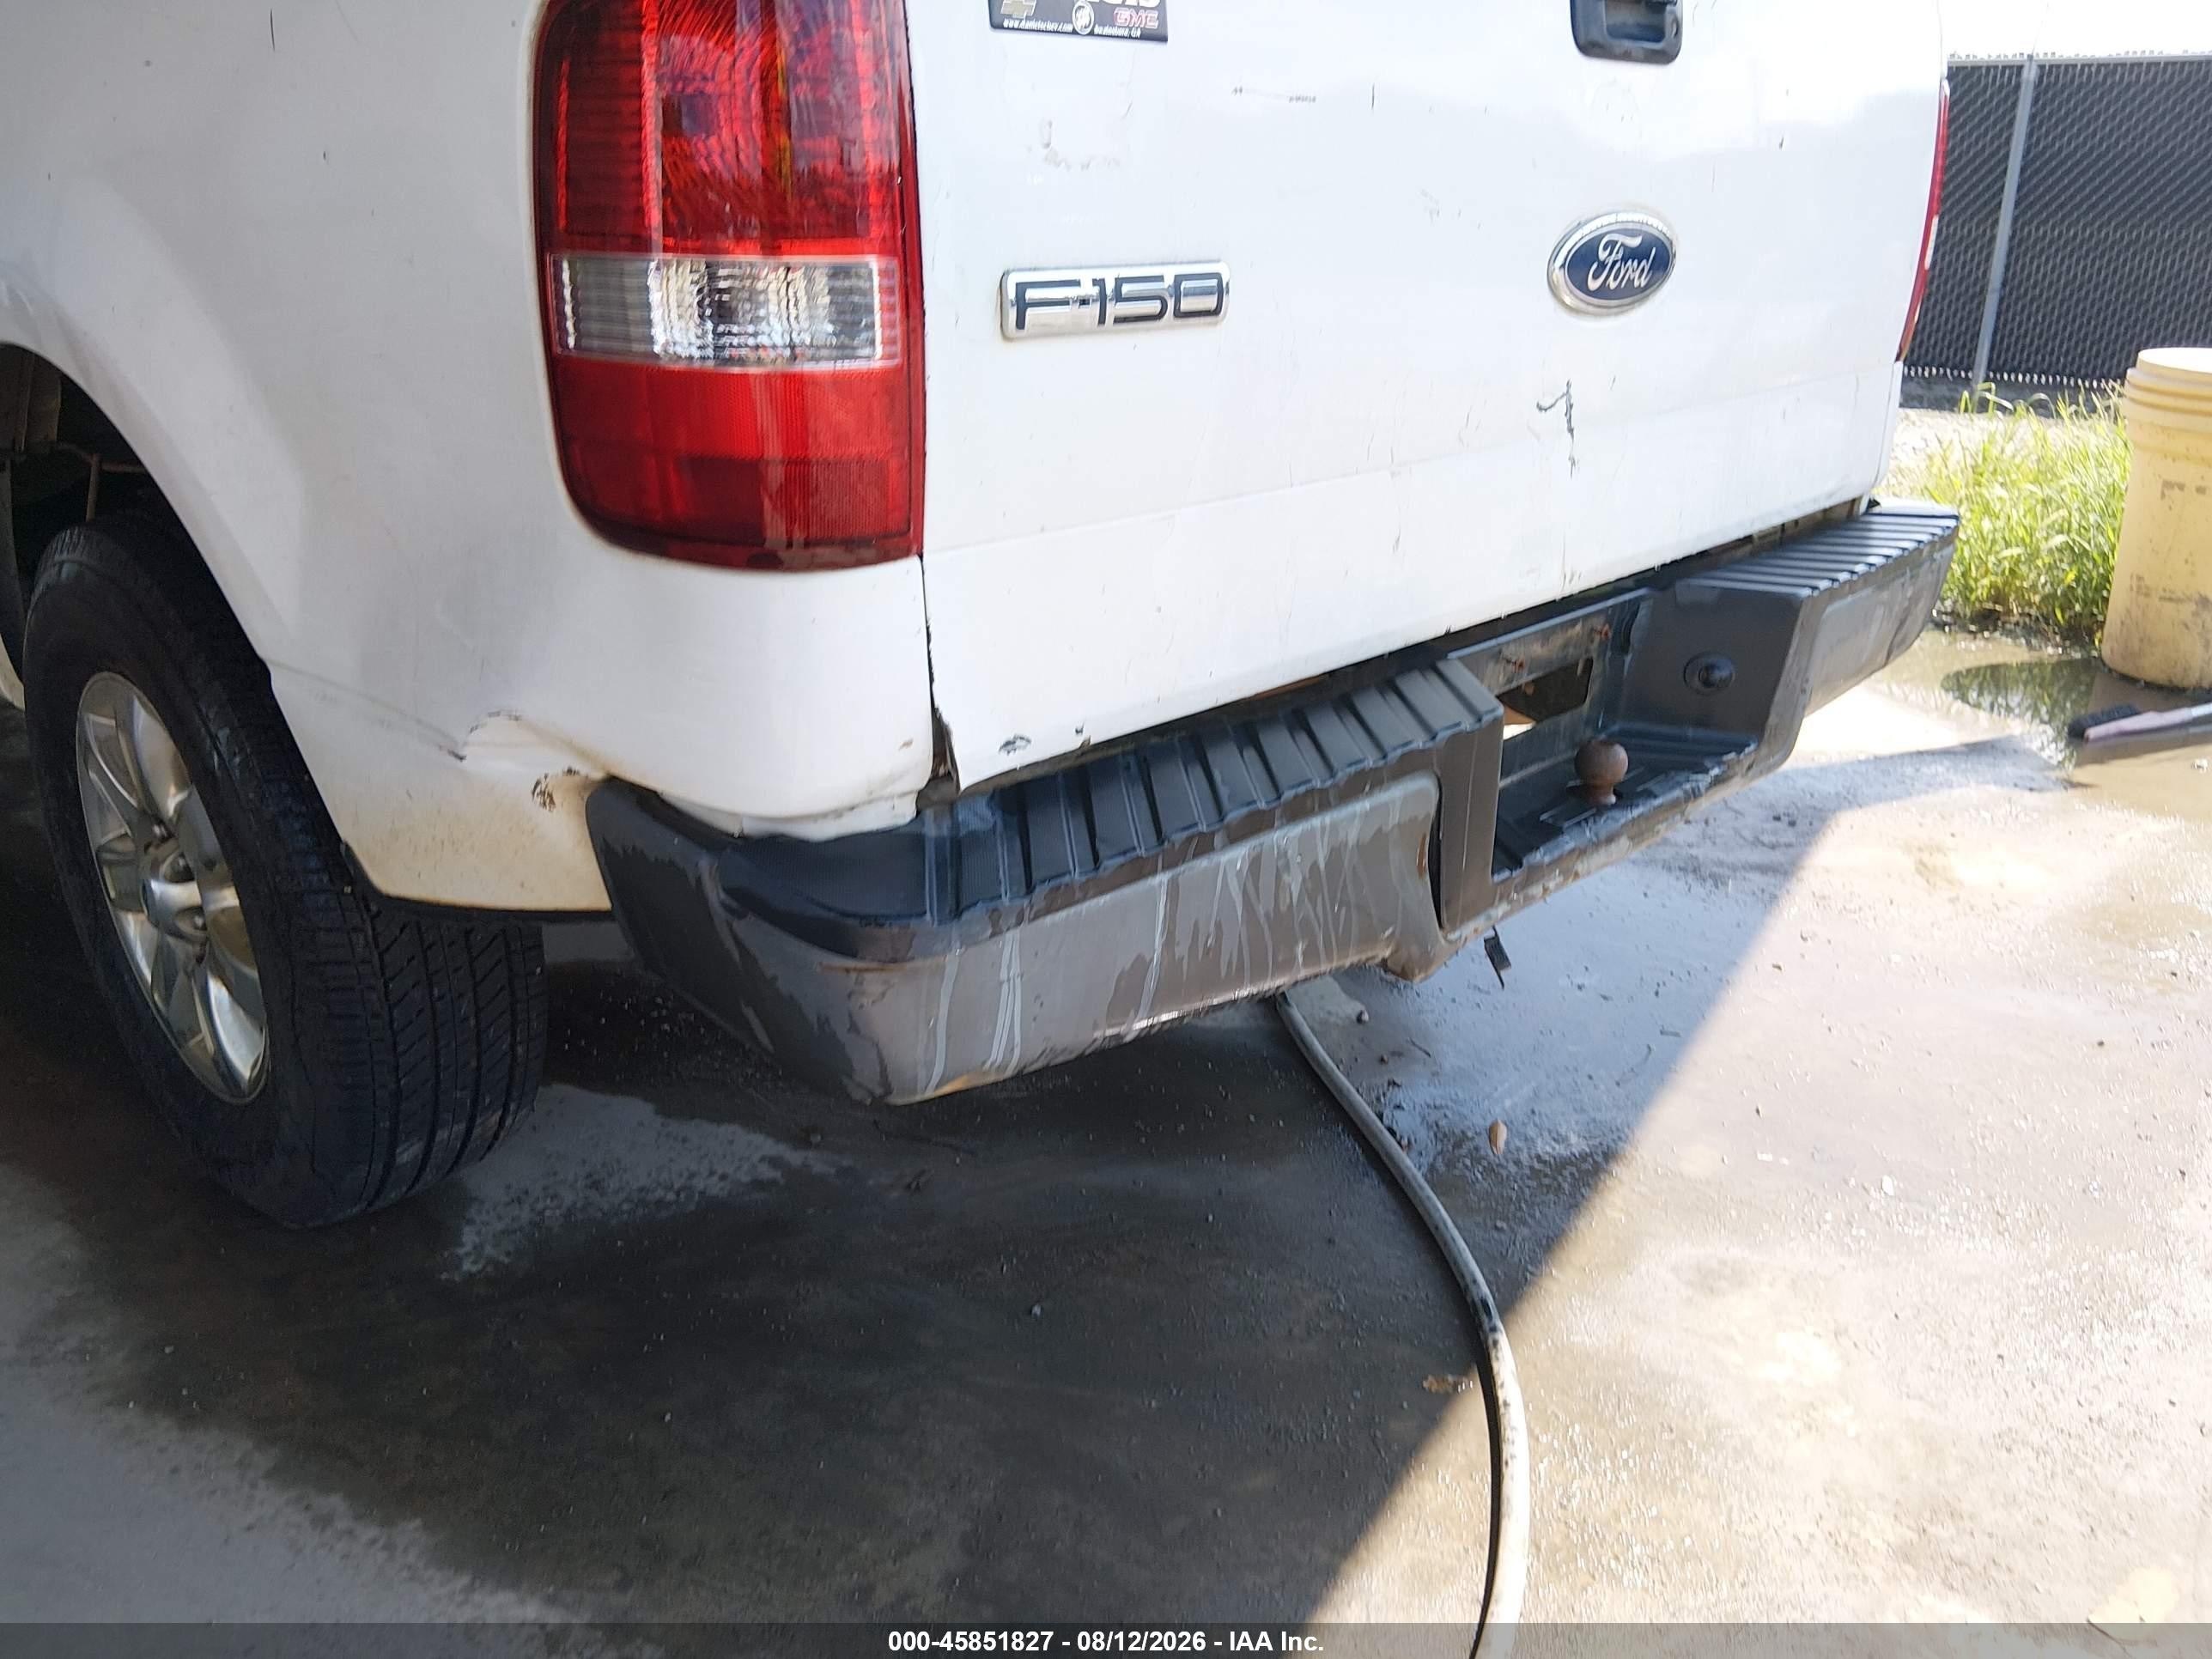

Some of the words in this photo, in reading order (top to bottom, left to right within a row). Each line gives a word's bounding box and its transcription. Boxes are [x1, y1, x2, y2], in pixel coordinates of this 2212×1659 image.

[1114, 8, 1158, 28] GMC
[1588, 233, 1656, 292] Ford
[1015, 272, 1224, 331] F-150
